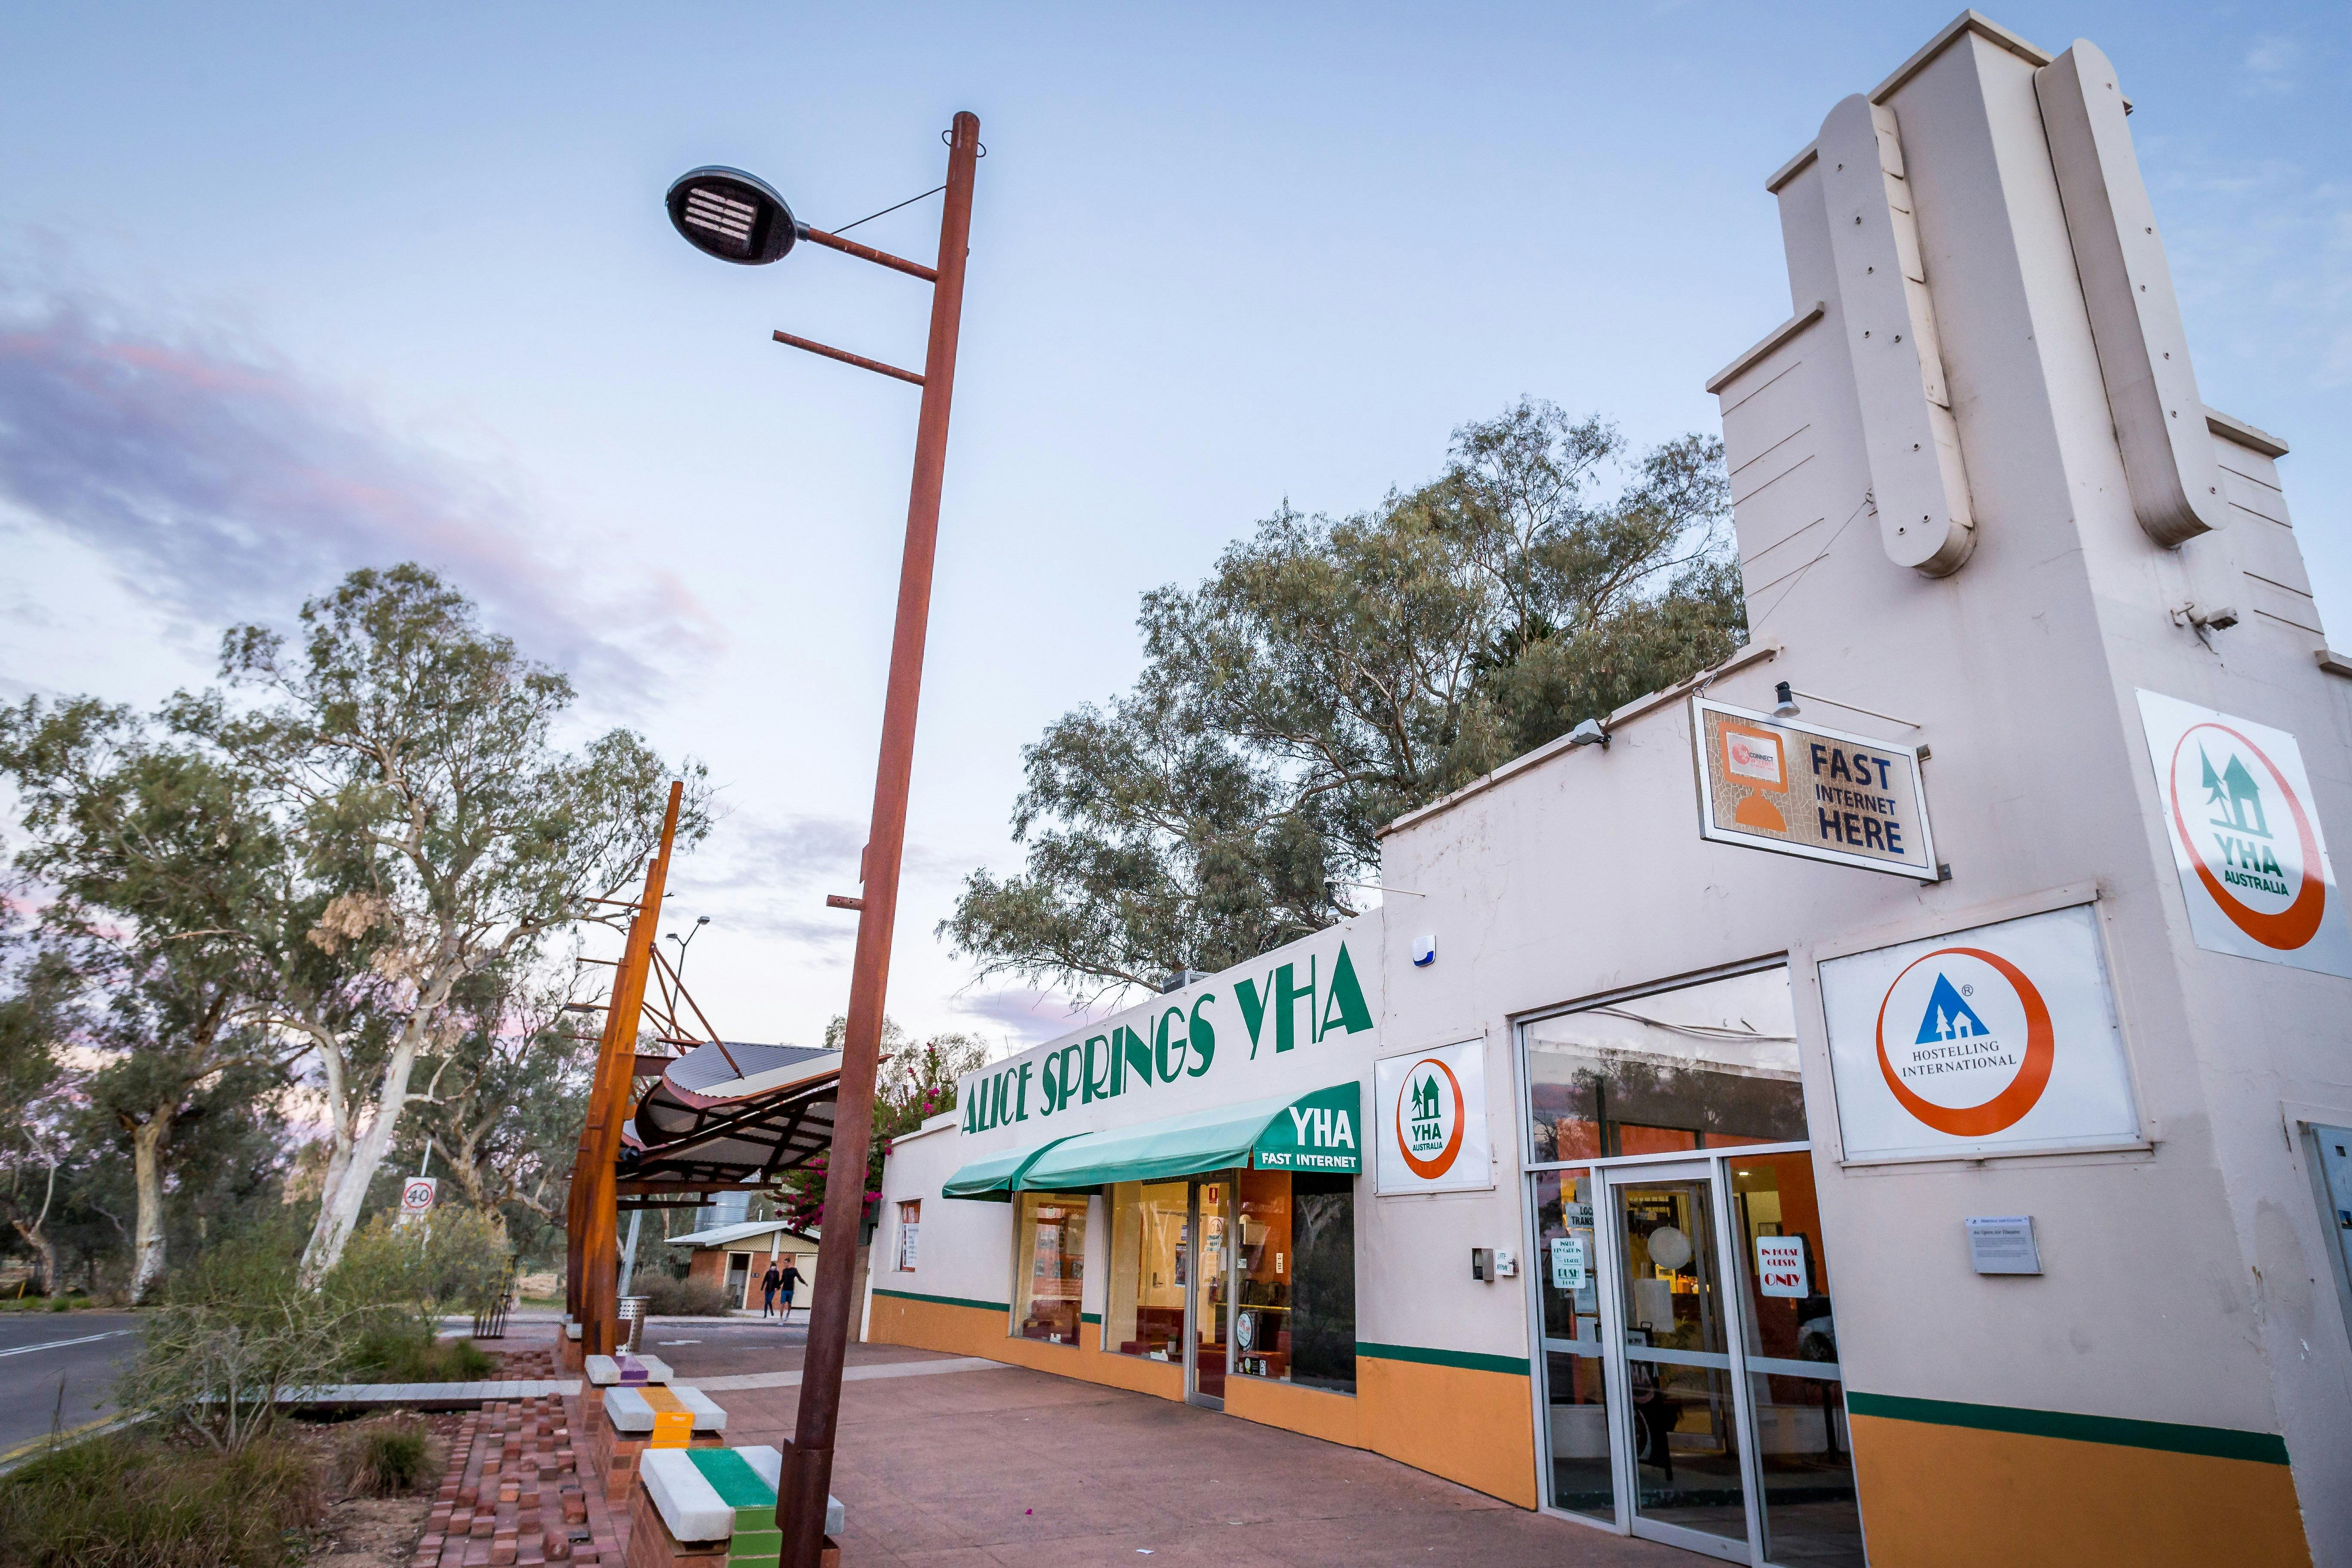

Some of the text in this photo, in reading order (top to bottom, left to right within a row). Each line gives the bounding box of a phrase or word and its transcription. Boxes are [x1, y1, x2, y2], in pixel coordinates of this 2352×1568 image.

[1750, 753, 1773, 762] CONNECT
[1810, 743, 1890, 790] FAST
[1816, 784, 1896, 815] INTERNET
[1819, 806, 1904, 854] HERE
[2213, 832, 2283, 878] YHA
[2225, 870, 2290, 897] AUSTRALIA
[961, 940, 1373, 1136] ALICE SPRINGS YHA
[1912, 1040, 2000, 1062] HOSTELLING
[1902, 1054, 2017, 1078] INTERNATIONAL
[1289, 1106, 1355, 1148] YHA
[1412, 1123, 1442, 1142] YHA
[1412, 1142, 1443, 1152] AUSTRALIA
[1262, 1153, 1356, 1167] FAST INTERNET
[408, 1189, 429, 1202] 40
[1558, 1268, 1580, 1277] PUSH
[1764, 1273, 1801, 1287] ONLY
